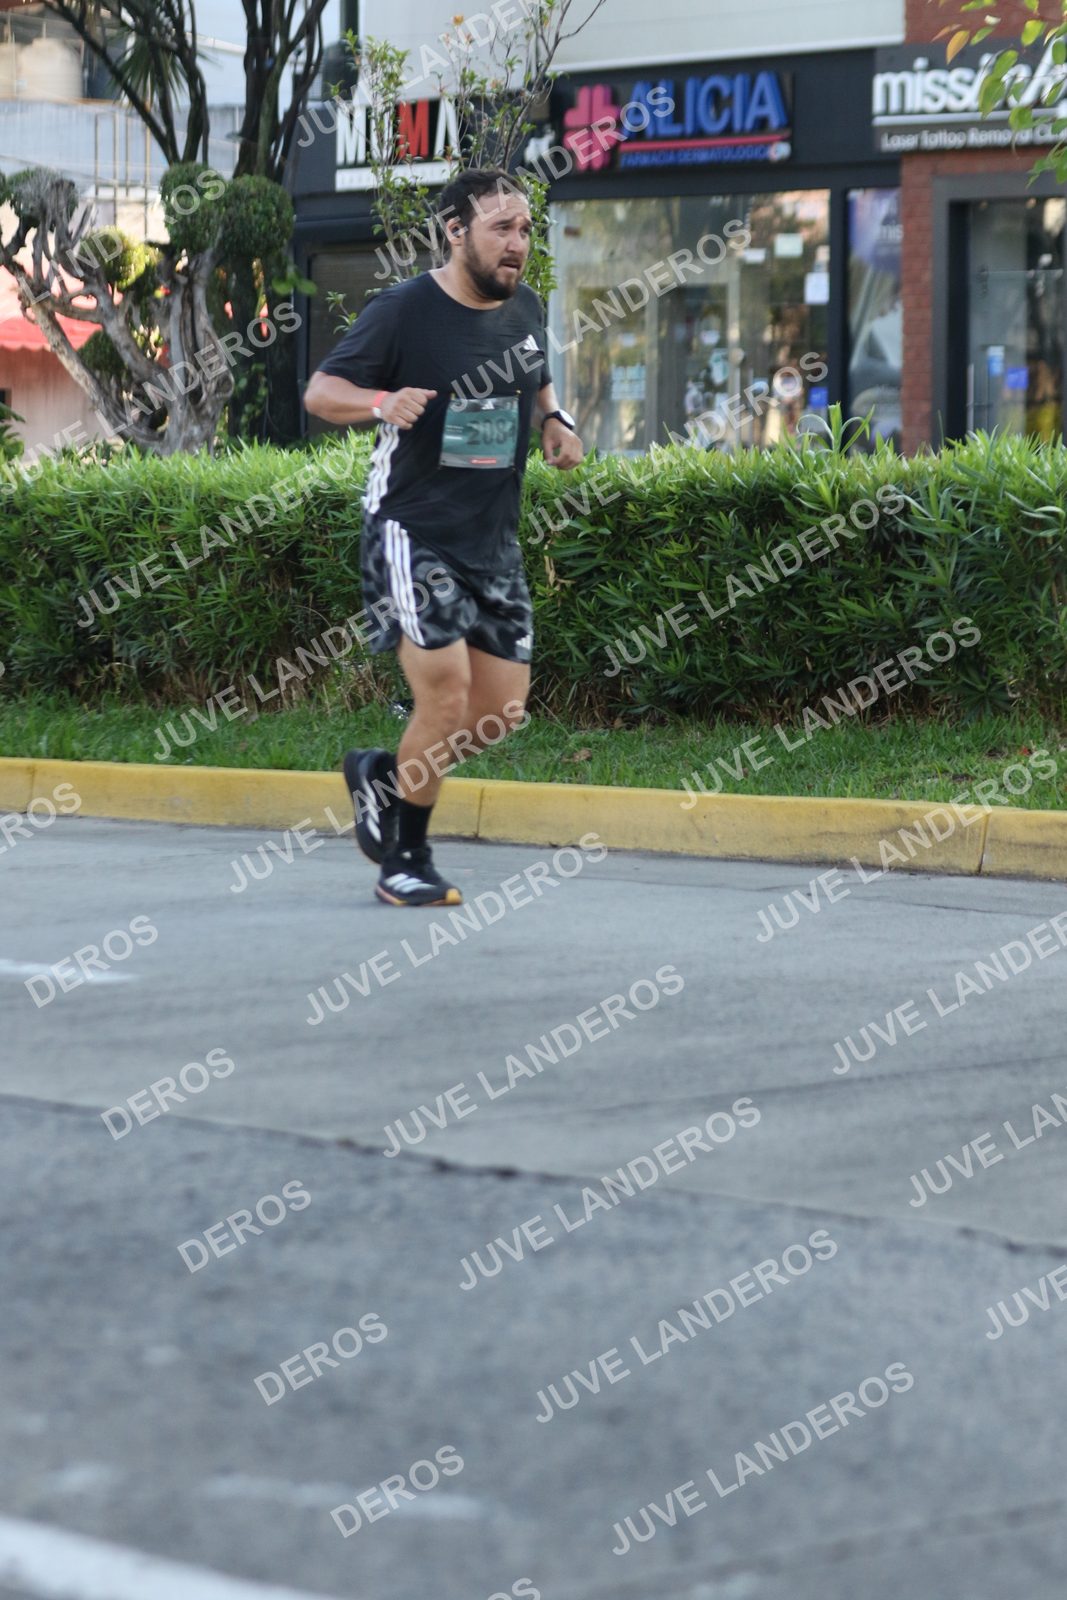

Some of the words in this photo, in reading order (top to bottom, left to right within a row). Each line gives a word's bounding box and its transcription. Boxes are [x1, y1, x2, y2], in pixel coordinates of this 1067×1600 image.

[622, 70, 788, 138] ALICIA
[881, 132, 919, 152] Laser
[921, 129, 966, 150] Tattoo
[621, 151, 676, 168] FARMACIA
